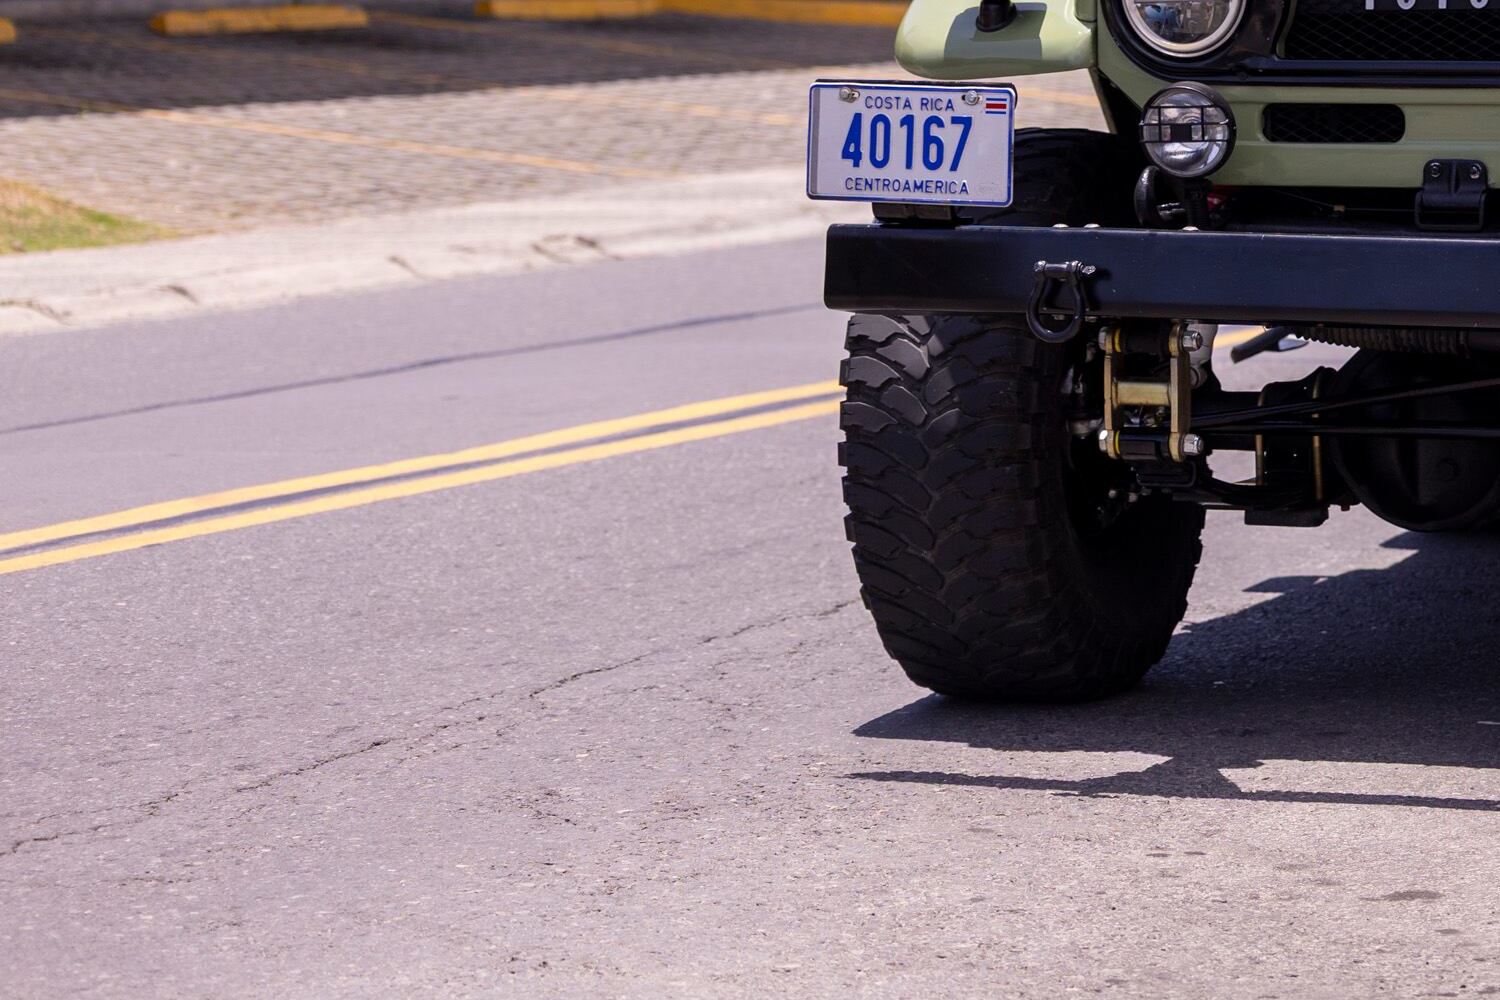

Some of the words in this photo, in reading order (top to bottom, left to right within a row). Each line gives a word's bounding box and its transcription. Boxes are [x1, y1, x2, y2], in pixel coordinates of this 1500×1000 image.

[864, 96, 913, 111] COSTA
[920, 97, 955, 112] RICA
[841, 113, 973, 172] 40167
[844, 177, 970, 195] CENTROAMERICA
